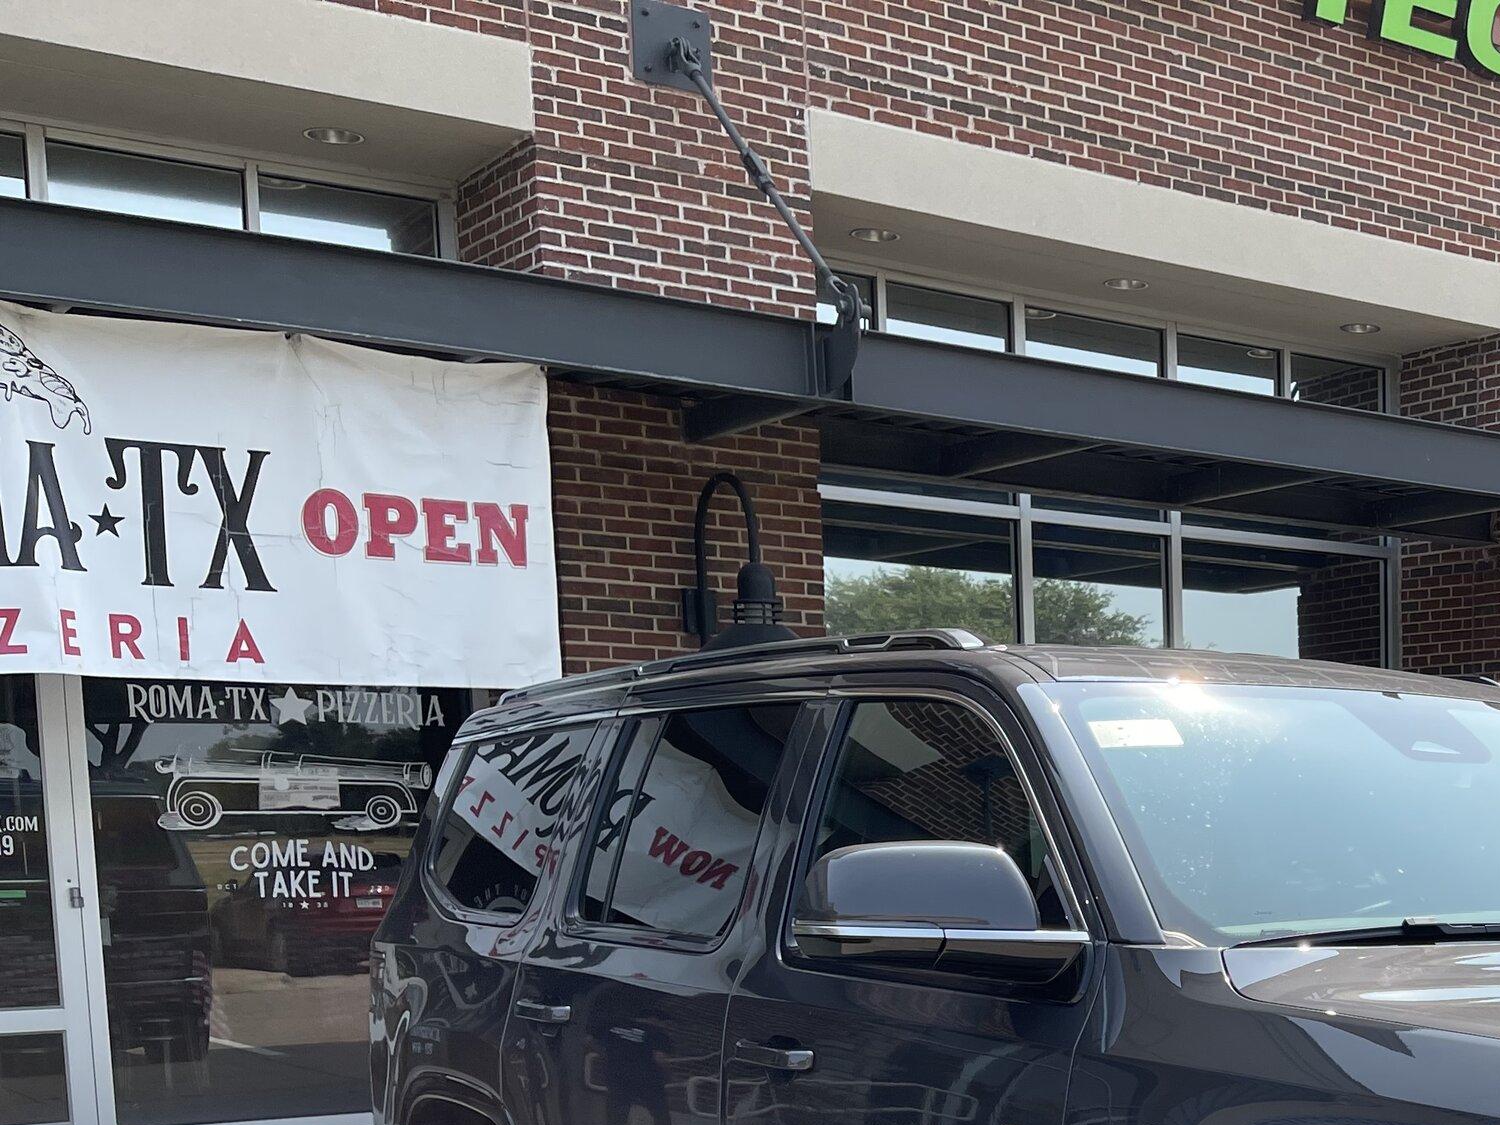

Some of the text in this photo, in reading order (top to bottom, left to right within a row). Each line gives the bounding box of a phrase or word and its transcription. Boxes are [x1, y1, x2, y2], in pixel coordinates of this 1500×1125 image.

[301, 487, 529, 569] OPEN
[316, 687, 445, 731] PIZZERIA
[0, 816, 39, 832] .COM
[230, 838, 311, 871] COME
[253, 870, 353, 898] TAKE IT
